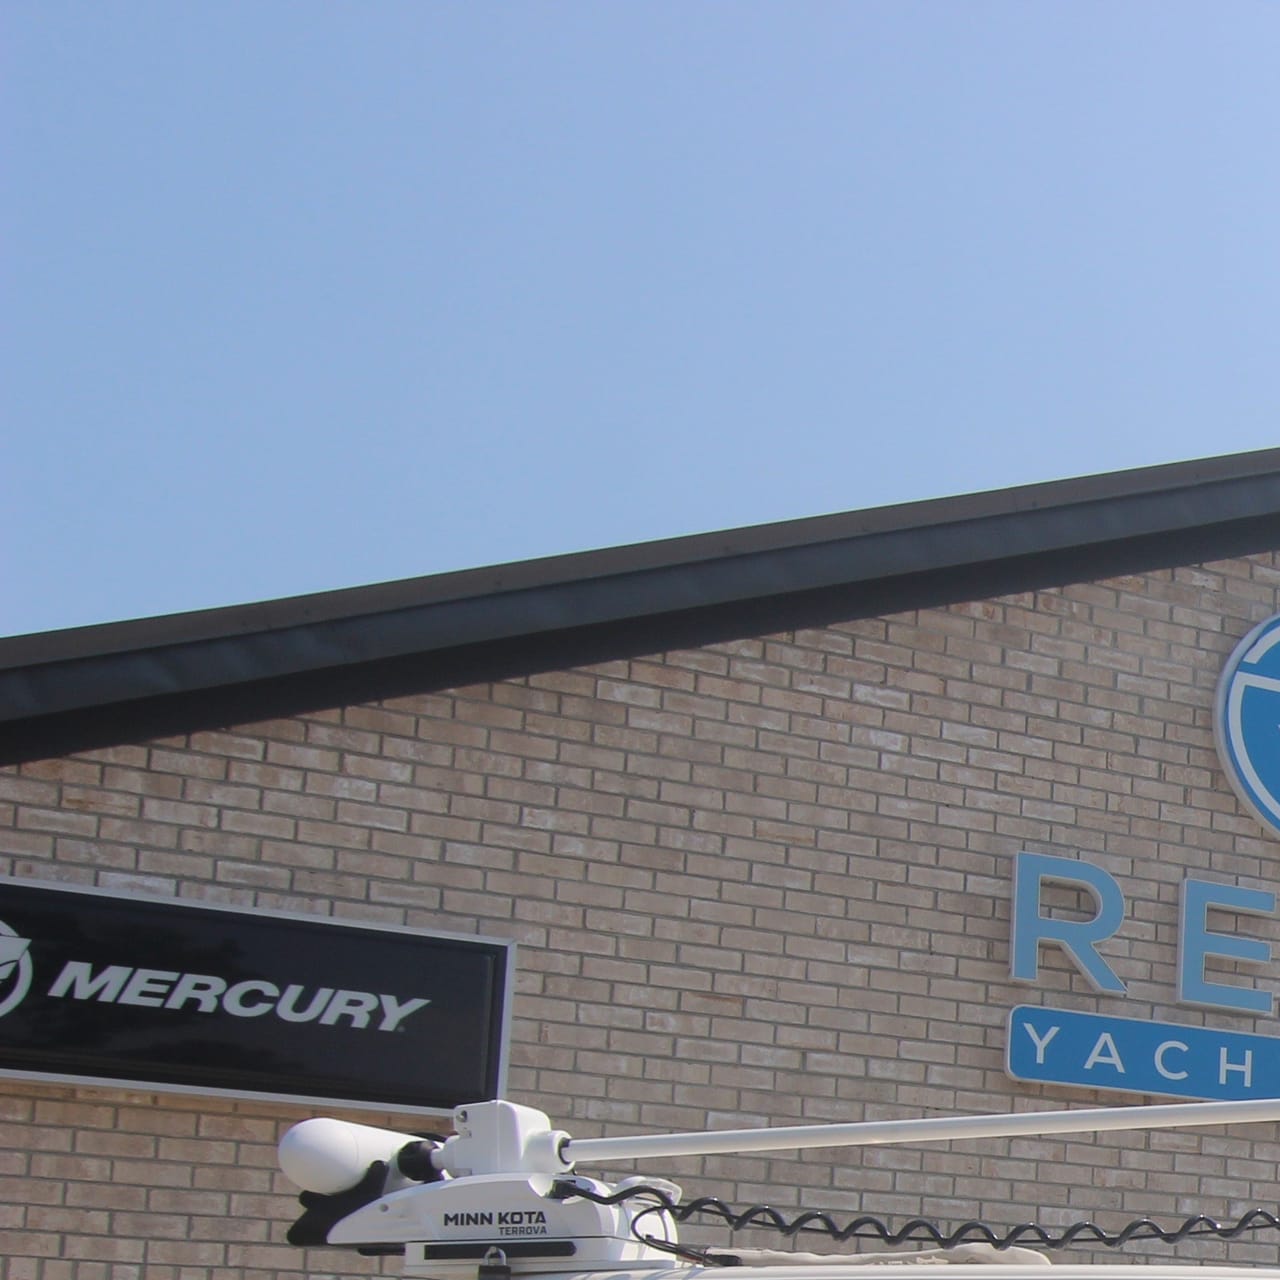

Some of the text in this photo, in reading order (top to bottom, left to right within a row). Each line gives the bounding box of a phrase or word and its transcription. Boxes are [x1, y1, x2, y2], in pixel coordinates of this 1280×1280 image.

[48, 961, 430, 1031] MERCURY
[444, 1211, 546, 1226] MINN KOTA
[499, 1226, 547, 1236] TERROVA
